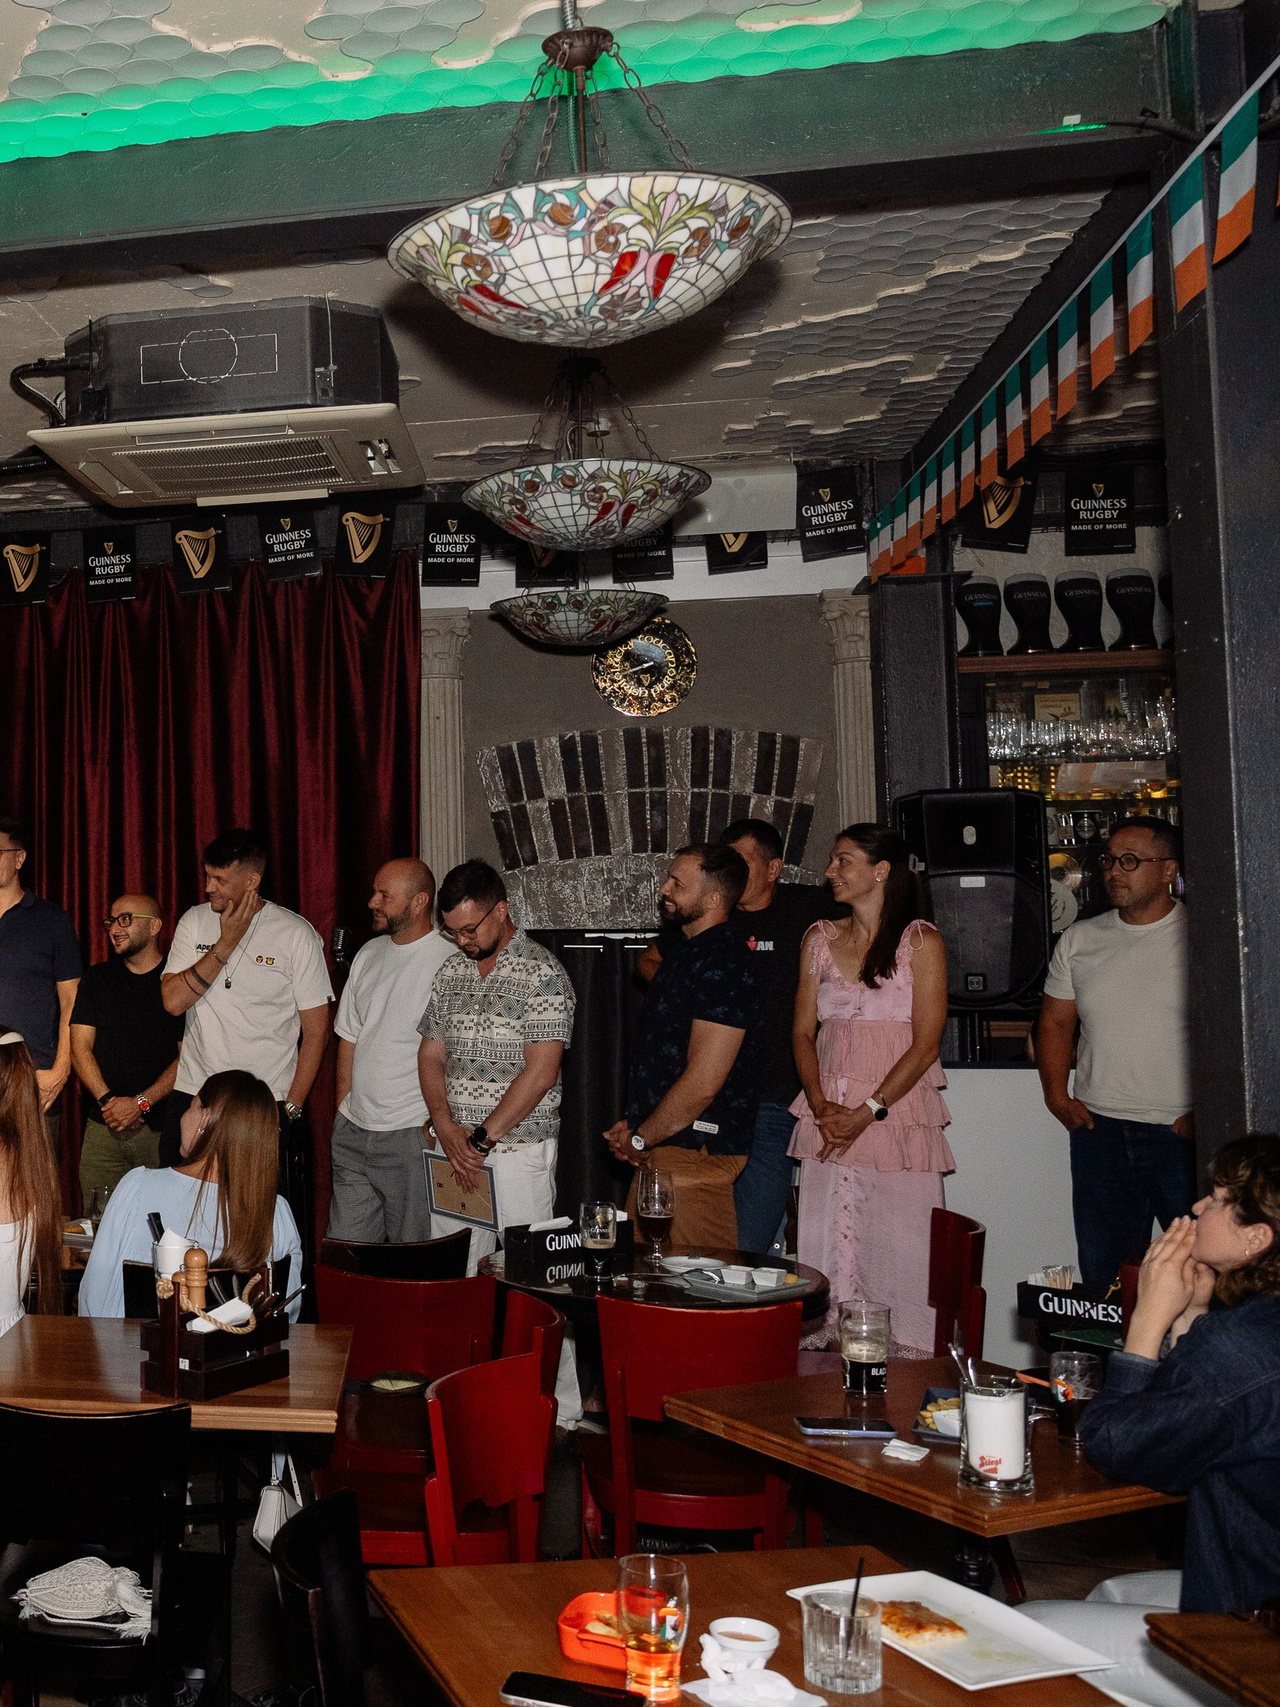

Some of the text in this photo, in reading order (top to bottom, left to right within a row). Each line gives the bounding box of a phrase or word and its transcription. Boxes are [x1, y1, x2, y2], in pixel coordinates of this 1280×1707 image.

[801, 499, 854, 517] GUINNESS
[1070, 498, 1128, 510] GUINNESS
[811, 511, 848, 526] RUGBY
[1079, 510, 1119, 519] RUGBY
[265, 529, 312, 544] GUINNESS
[428, 532, 476, 543] GUINNESS
[805, 529, 825, 538] MADE
[837, 524, 858, 532] MORE
[273, 540, 306, 553] RUGBY
[435, 544, 469, 553] RUGBY
[88, 554, 132, 567] GUINNESS
[296, 551, 314, 559] MORE
[95, 564, 126, 575] RUGBY
[545, 1233, 582, 1251] GUINN
